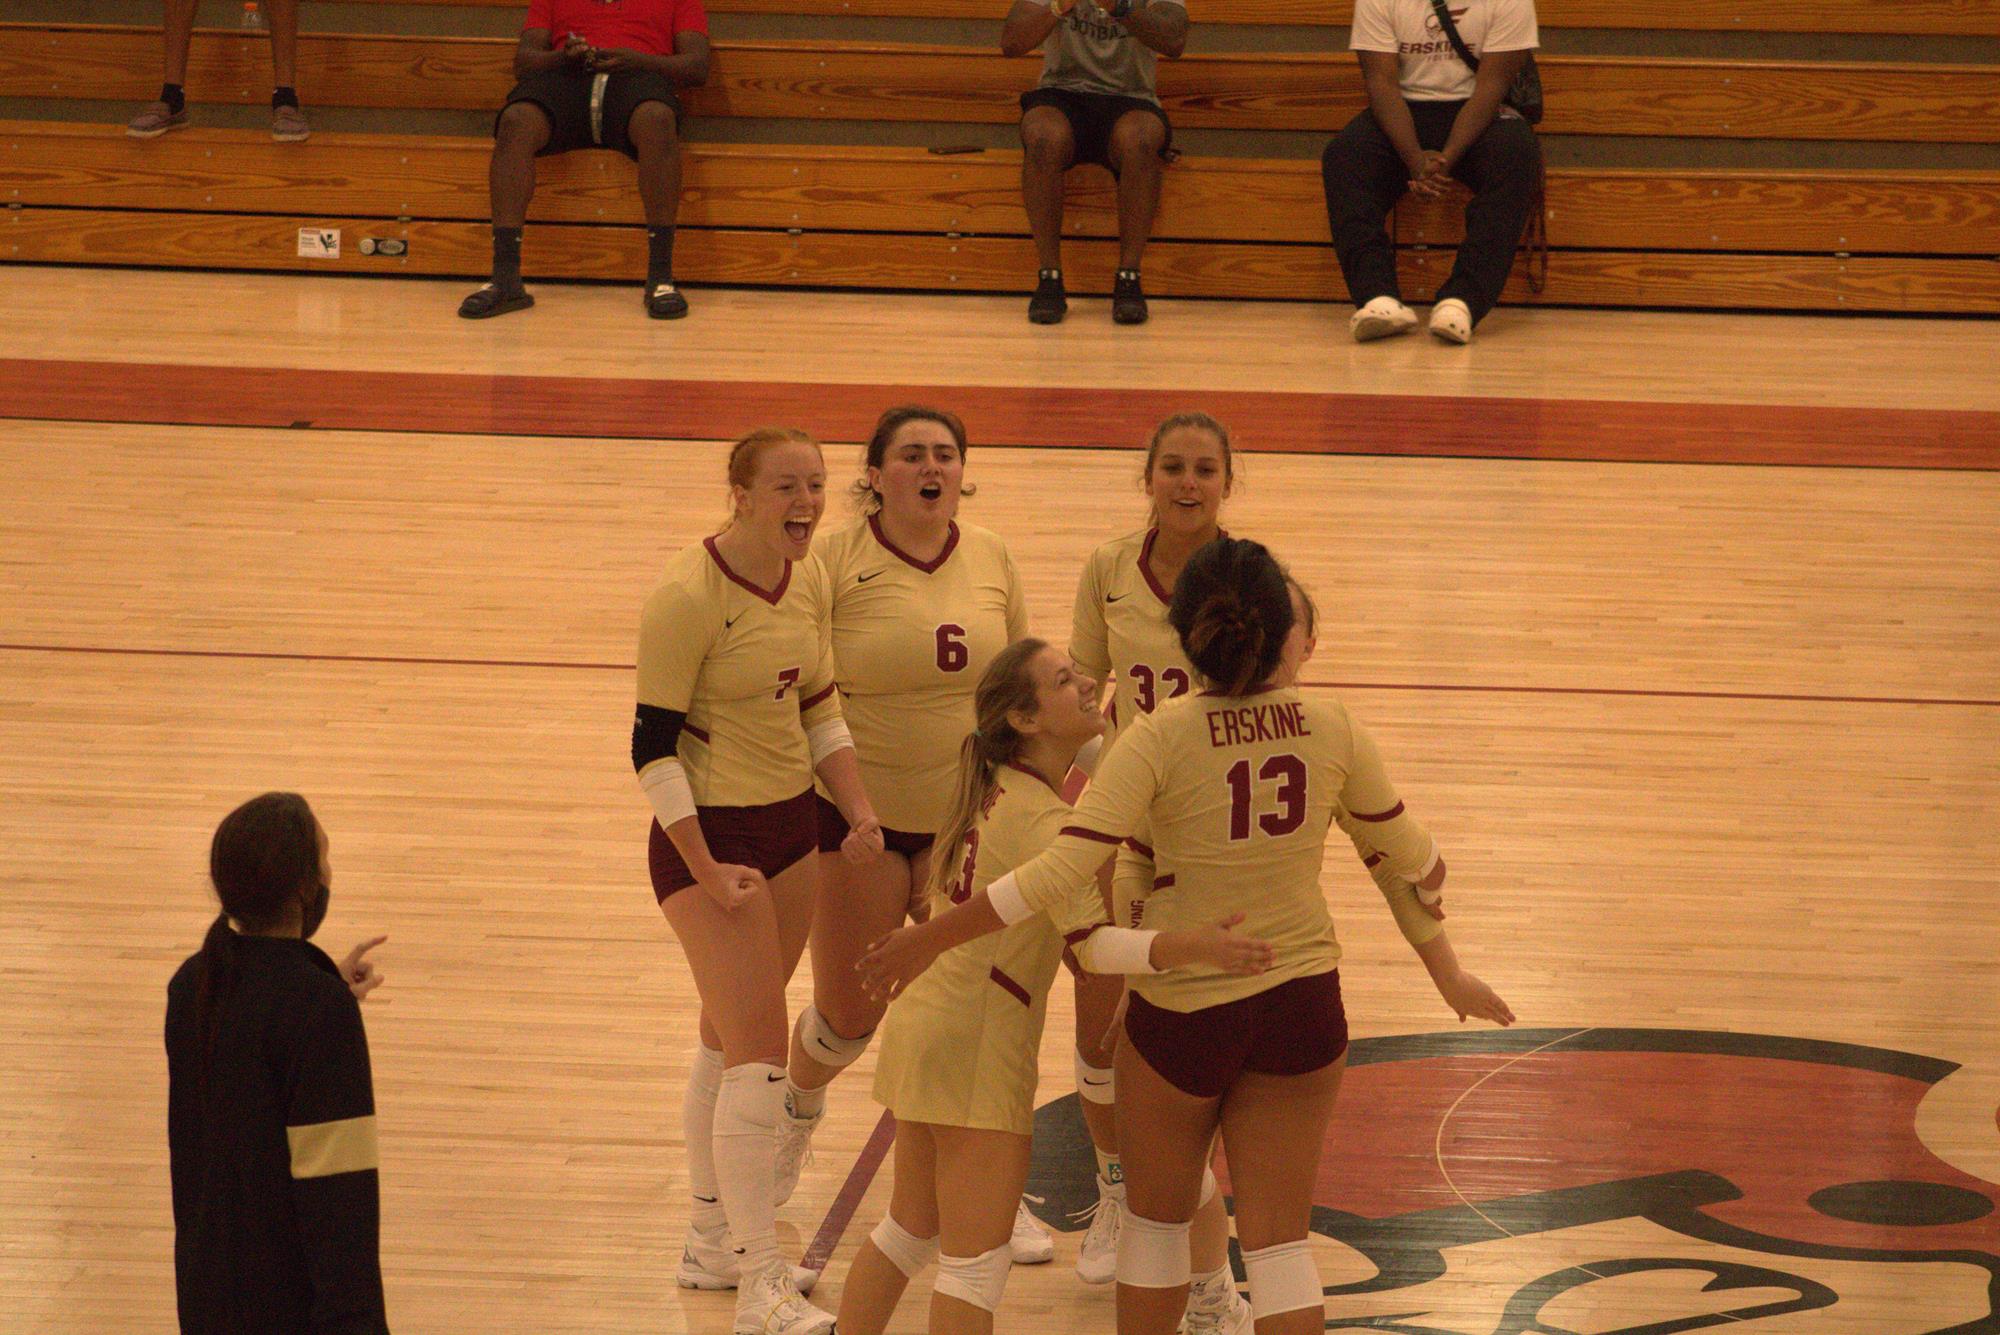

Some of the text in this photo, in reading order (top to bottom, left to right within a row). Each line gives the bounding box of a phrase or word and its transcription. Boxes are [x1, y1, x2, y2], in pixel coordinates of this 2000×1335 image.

[1399, 41, 1477, 54] ERSKIE
[935, 623, 969, 673] 6
[774, 667, 800, 700] 7
[1128, 663, 1190, 715] 32
[1206, 702, 1312, 748] ERSKINE
[1226, 753, 1307, 842] 13
